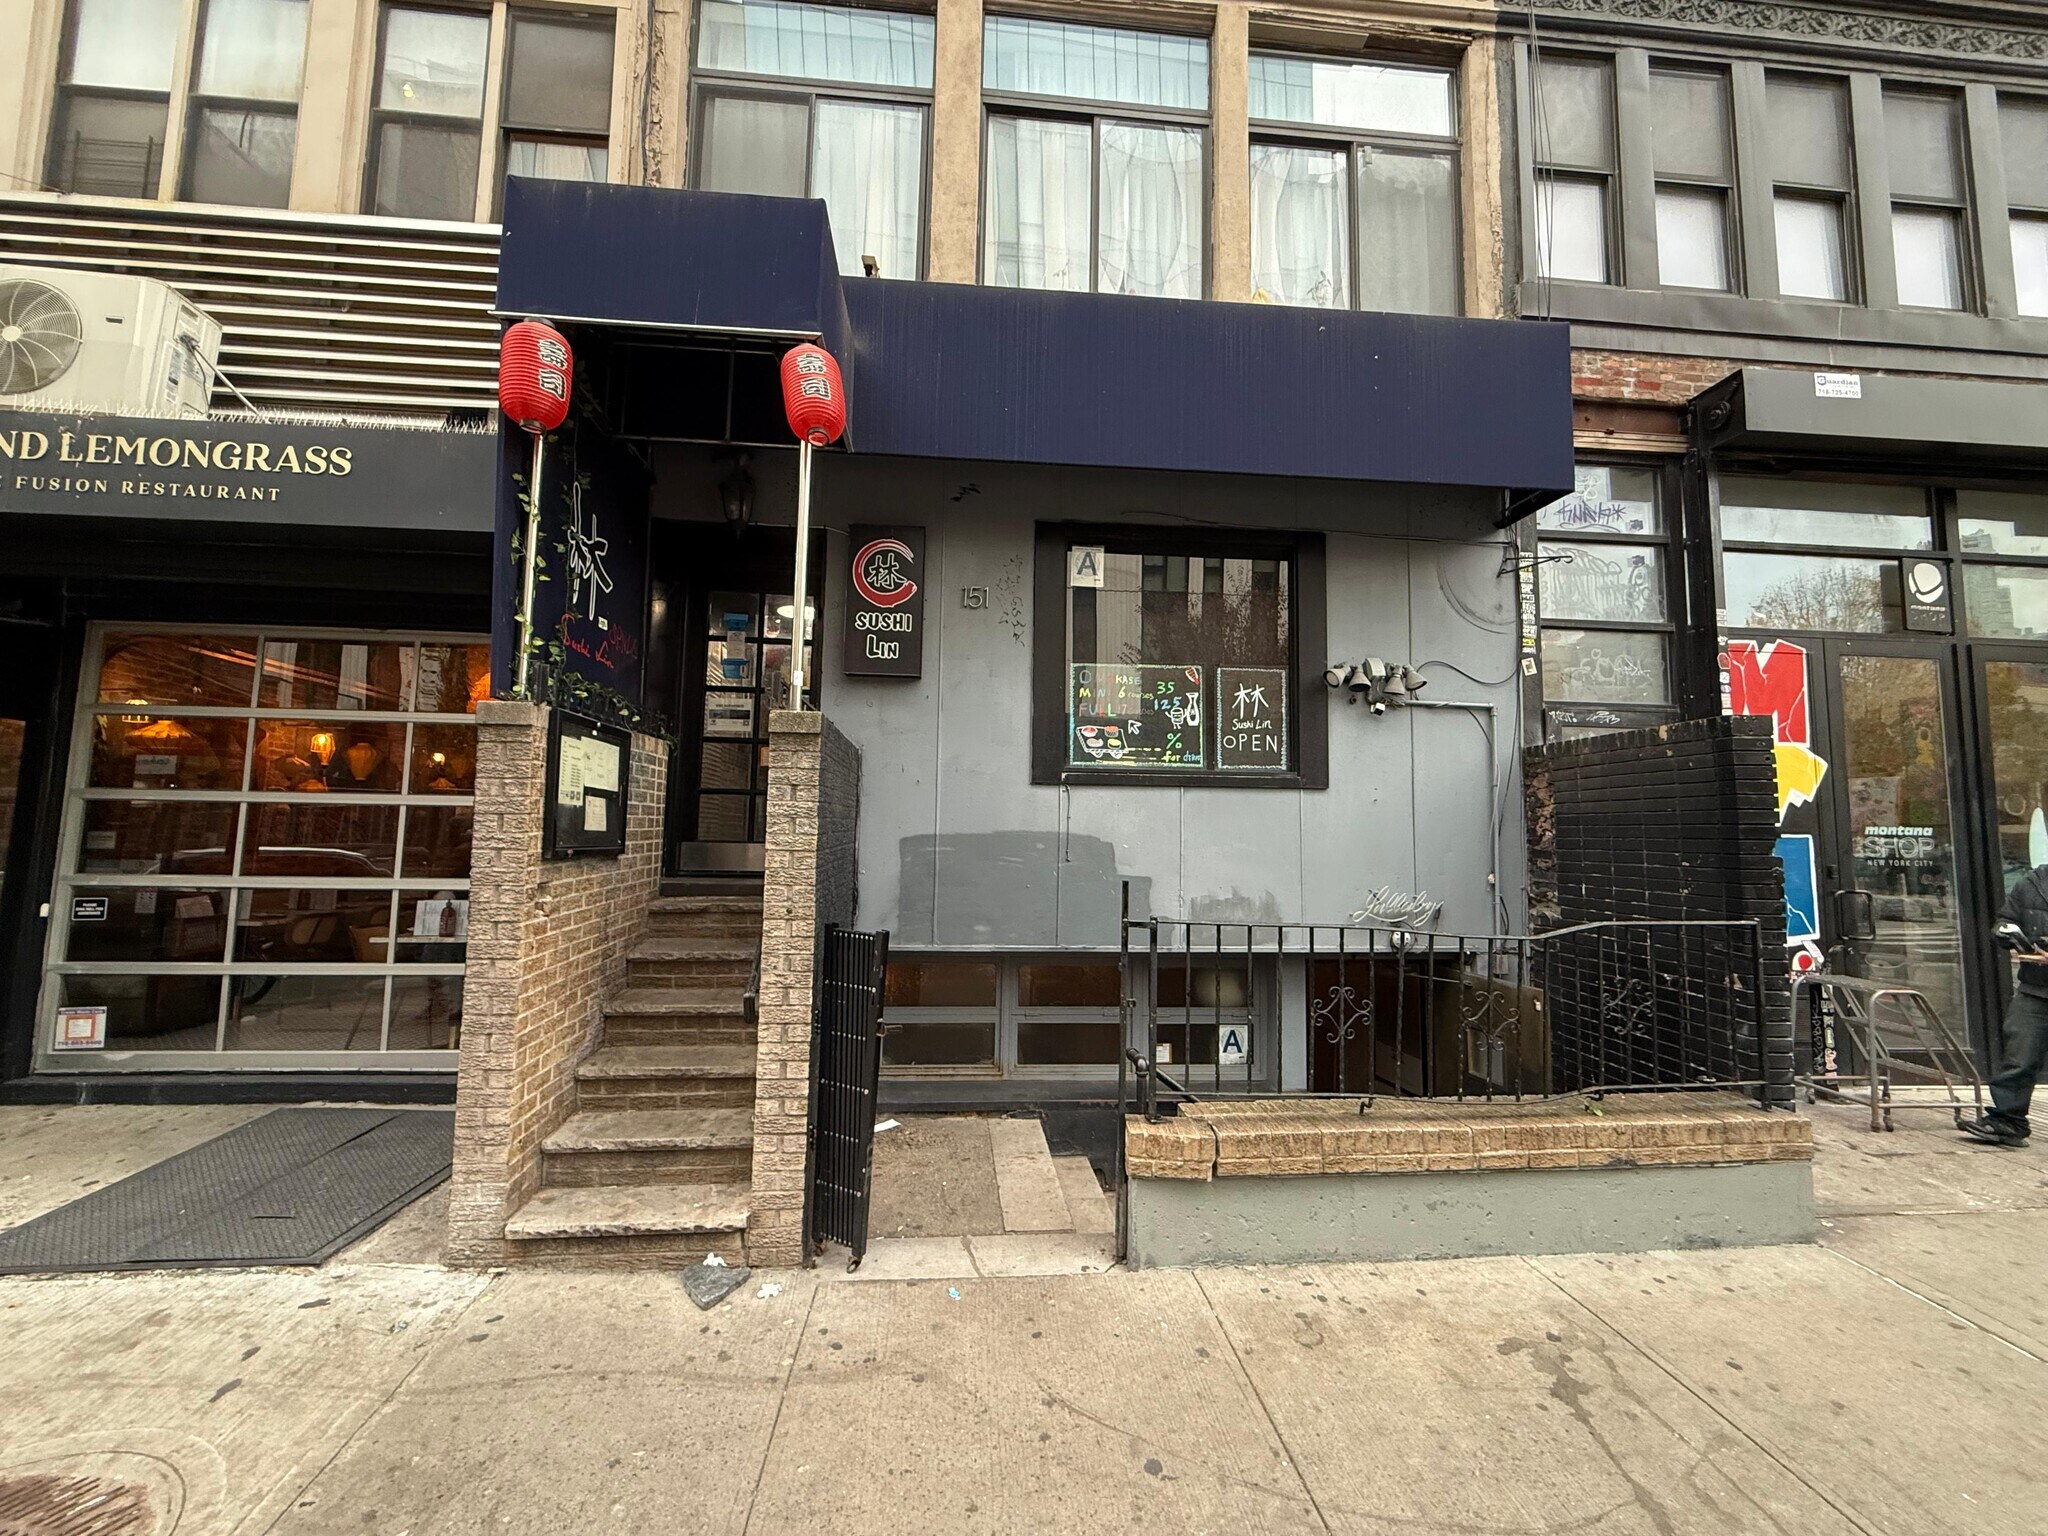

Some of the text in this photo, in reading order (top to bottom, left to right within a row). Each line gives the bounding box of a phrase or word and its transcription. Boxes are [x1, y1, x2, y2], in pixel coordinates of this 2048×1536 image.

[58, 430, 353, 477] LEMONGRASS
[15, 475, 109, 494] FUSION
[120, 480, 281, 502] RESTAURANT
[1076, 551, 1097, 576] A
[961, 585, 990, 609] 151
[855, 611, 913, 632] SUSHI
[1118, 686, 1126, 699] 6
[1157, 681, 1175, 695] 35
[1079, 702, 1117, 718] FULL
[1154, 696, 1182, 711] 125
[1232, 683, 1270, 720] 林
[1232, 718, 1273, 731] Sushi Lin
[1223, 733, 1279, 754] OPEN
[1864, 825, 1934, 837] montana
[1862, 836, 1936, 859] SHOP
[1867, 859, 1934, 868] NEW YORK CITY
[1222, 1029, 1243, 1054] A
